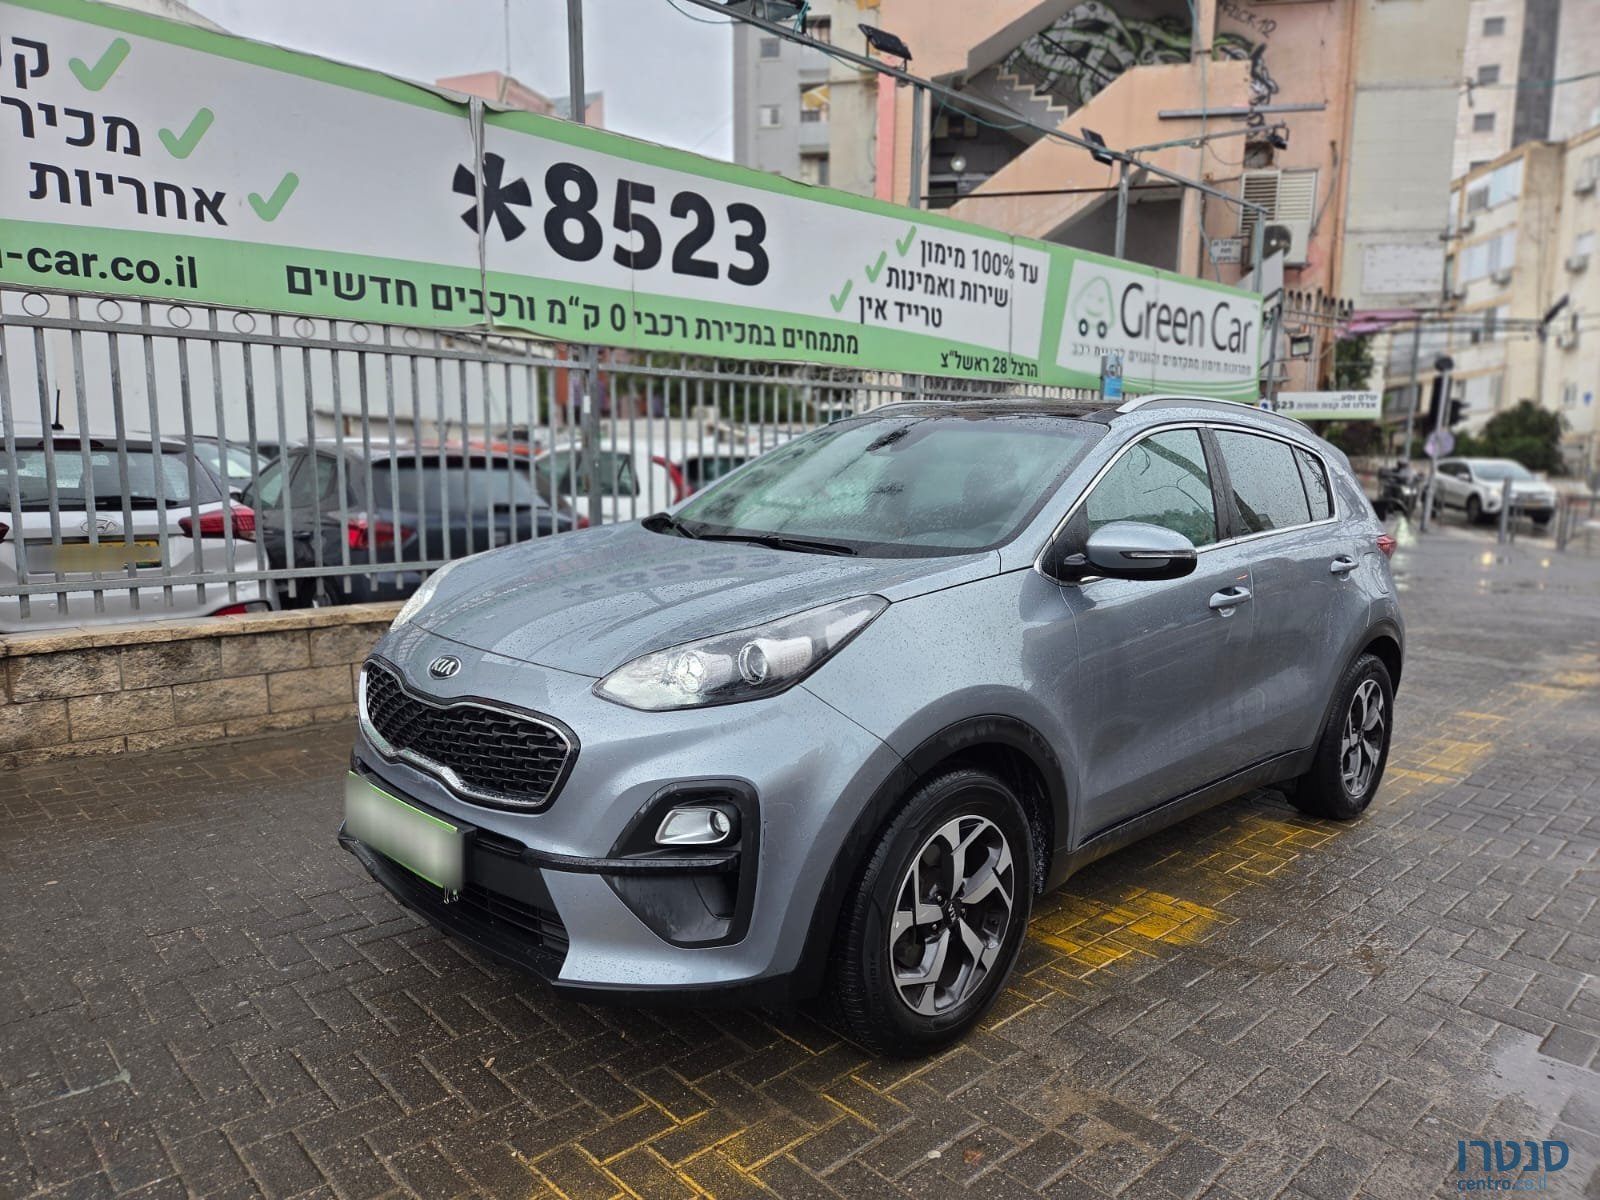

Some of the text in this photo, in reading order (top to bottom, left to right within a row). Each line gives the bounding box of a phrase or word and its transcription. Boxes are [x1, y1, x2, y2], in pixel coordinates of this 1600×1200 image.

[1, 36, 50, 90] ק
[29, 161, 228, 226] אחריות
[0, 246, 198, 289] -car.co.il
[920, 239, 1039, 284] עד 100% מימון
[286, 265, 418, 308] חדשים
[431, 283, 536, 321] ורכבים
[886, 266, 1009, 308] שירות ואמינות
[609, 302, 626, 332] 0
[633, 310, 689, 339] רכבי
[858, 294, 943, 328] טרייד אין
[1120, 281, 1253, 354] Green Car
[695, 316, 777, 347] במכירת
[783, 326, 859, 355] מתמחים
[991, 356, 1007, 374] 28
[1011, 357, 1039, 378] הרצל
